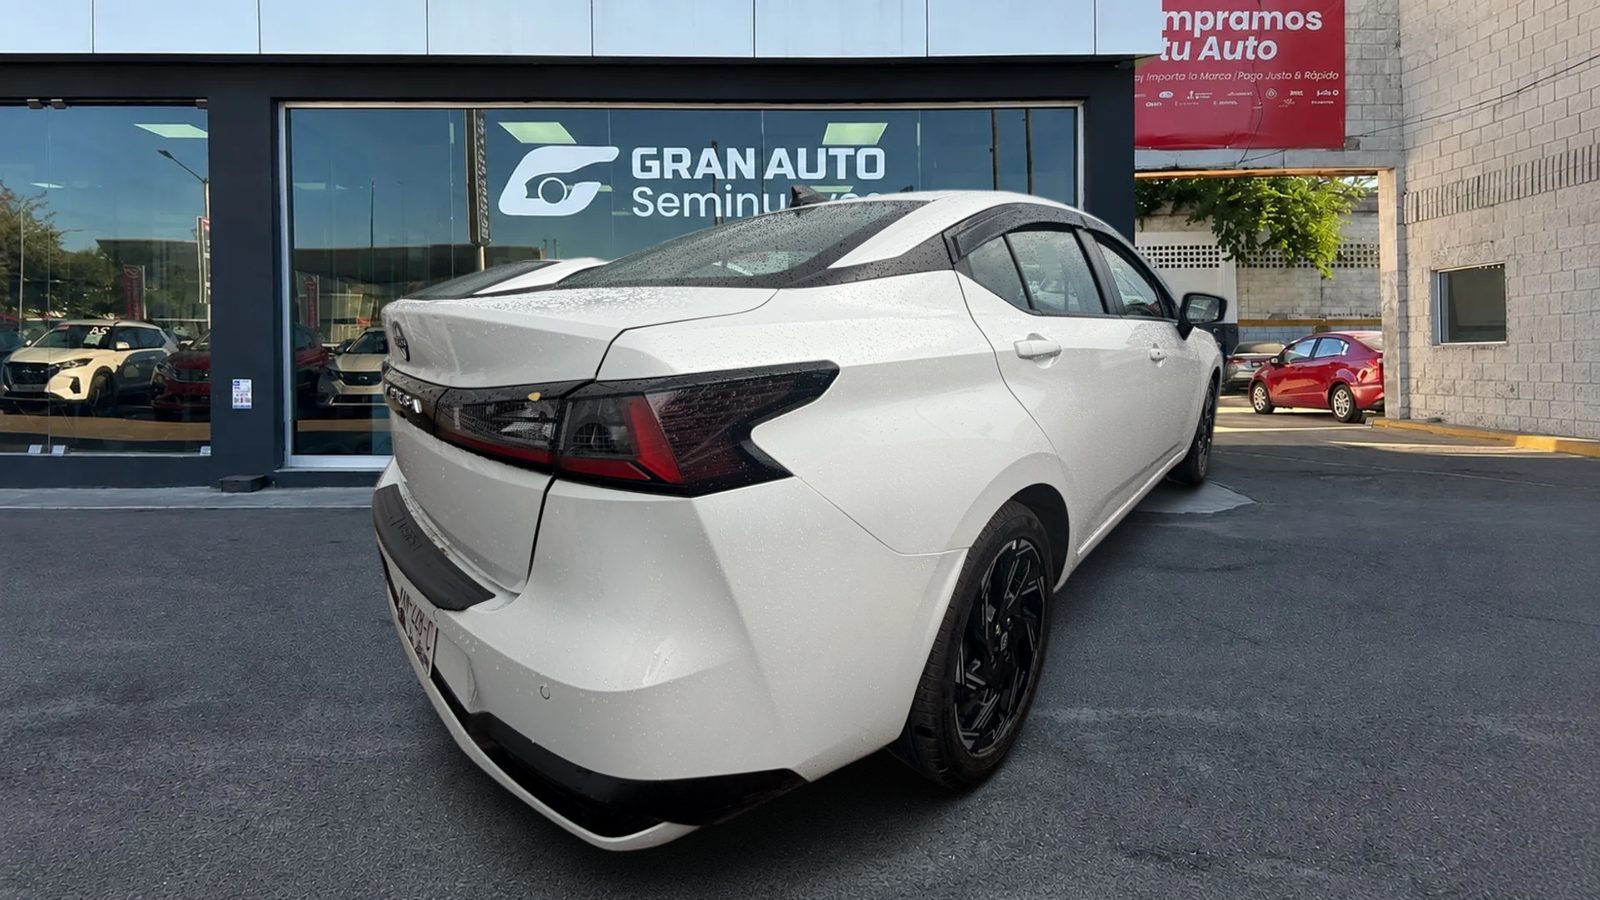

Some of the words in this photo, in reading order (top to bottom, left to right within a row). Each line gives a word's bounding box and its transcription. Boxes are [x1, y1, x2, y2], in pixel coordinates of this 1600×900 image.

[1160, 36, 1191, 61] tu
[1198, 35, 1278, 61] Auto
[1146, 72, 1186, 84] Importa
[1188, 71, 1198, 81] la
[1200, 72, 1232, 81] Marca
[1266, 71, 1293, 81] Justo
[631, 147, 756, 179] GRAN
[763, 147, 886, 179] AUTO
[632, 183, 882, 218] Seminu
